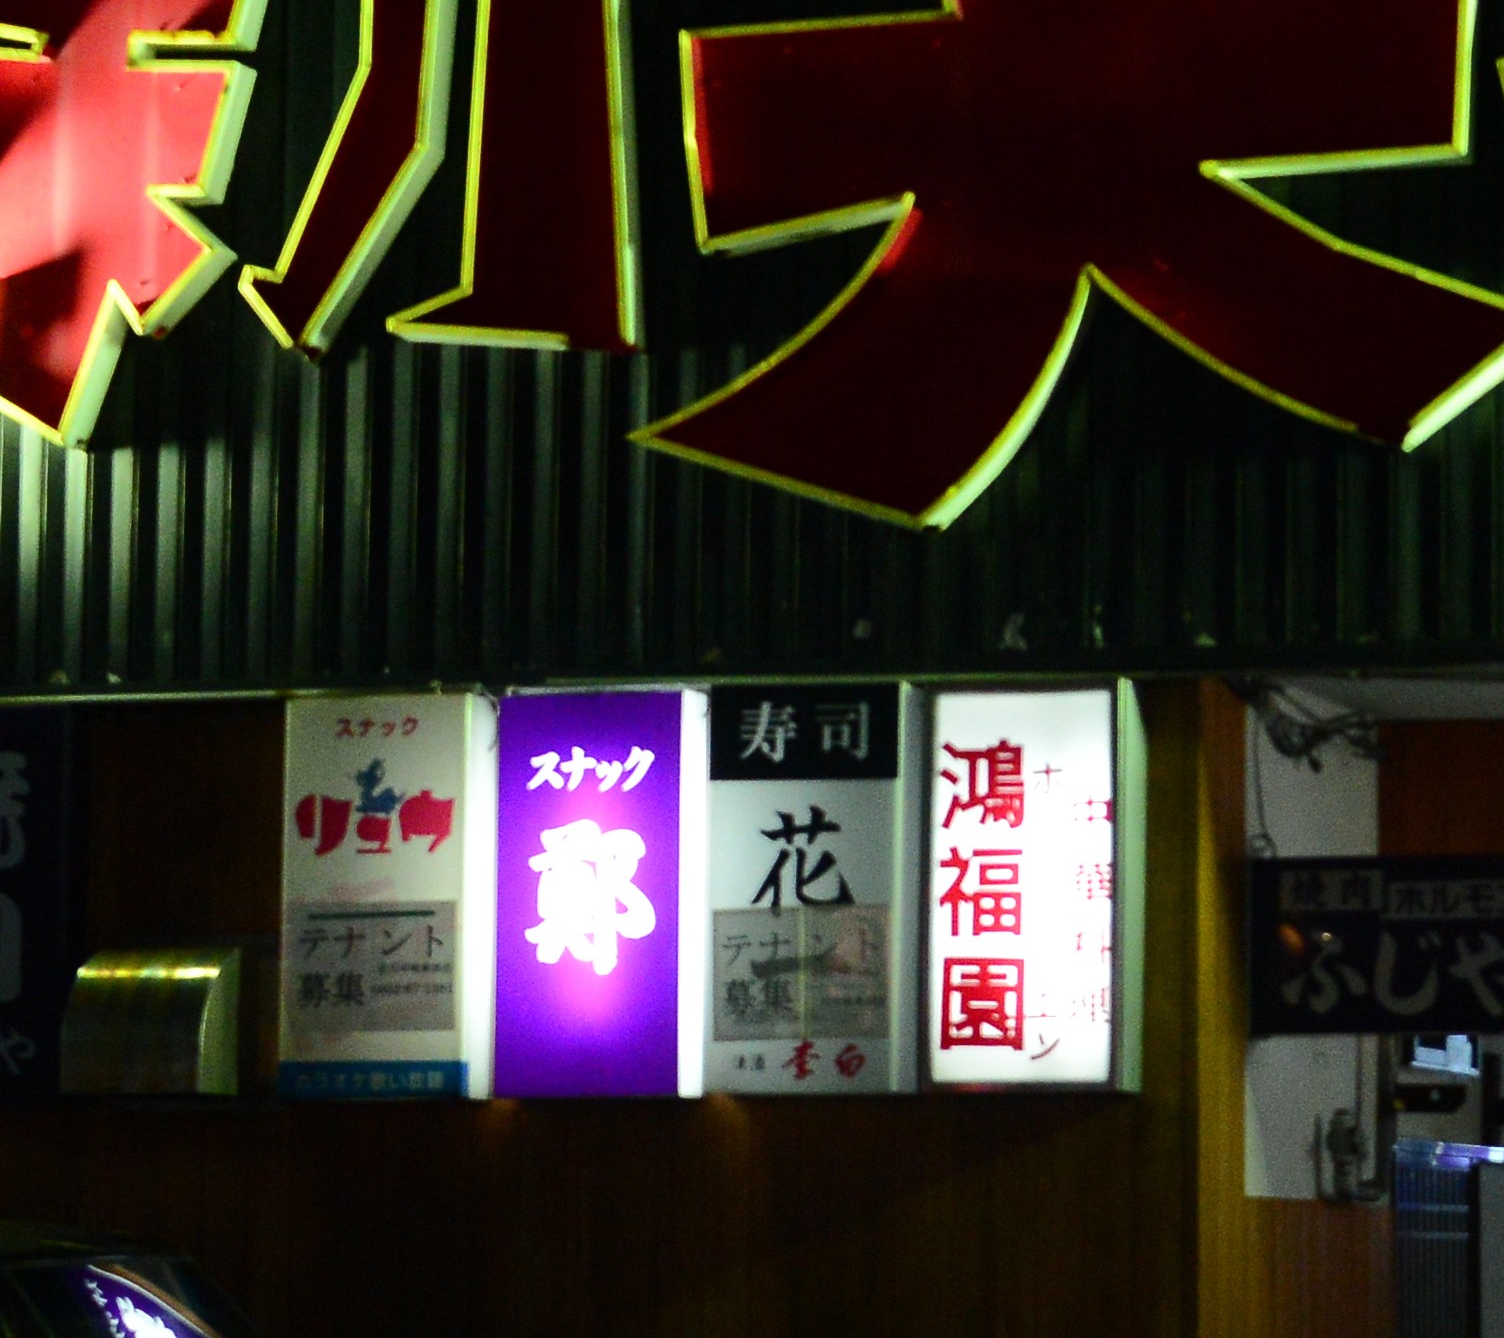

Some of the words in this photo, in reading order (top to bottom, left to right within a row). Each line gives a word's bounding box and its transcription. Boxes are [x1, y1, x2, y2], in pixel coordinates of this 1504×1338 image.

[334, 716, 420, 739] スナック
[739, 701, 871, 763] 寿司
[525, 746, 656, 793] スナック
[939, 737, 1025, 1051] 鴻福園
[299, 924, 444, 960] テナント
[298, 971, 366, 1009] 募集
